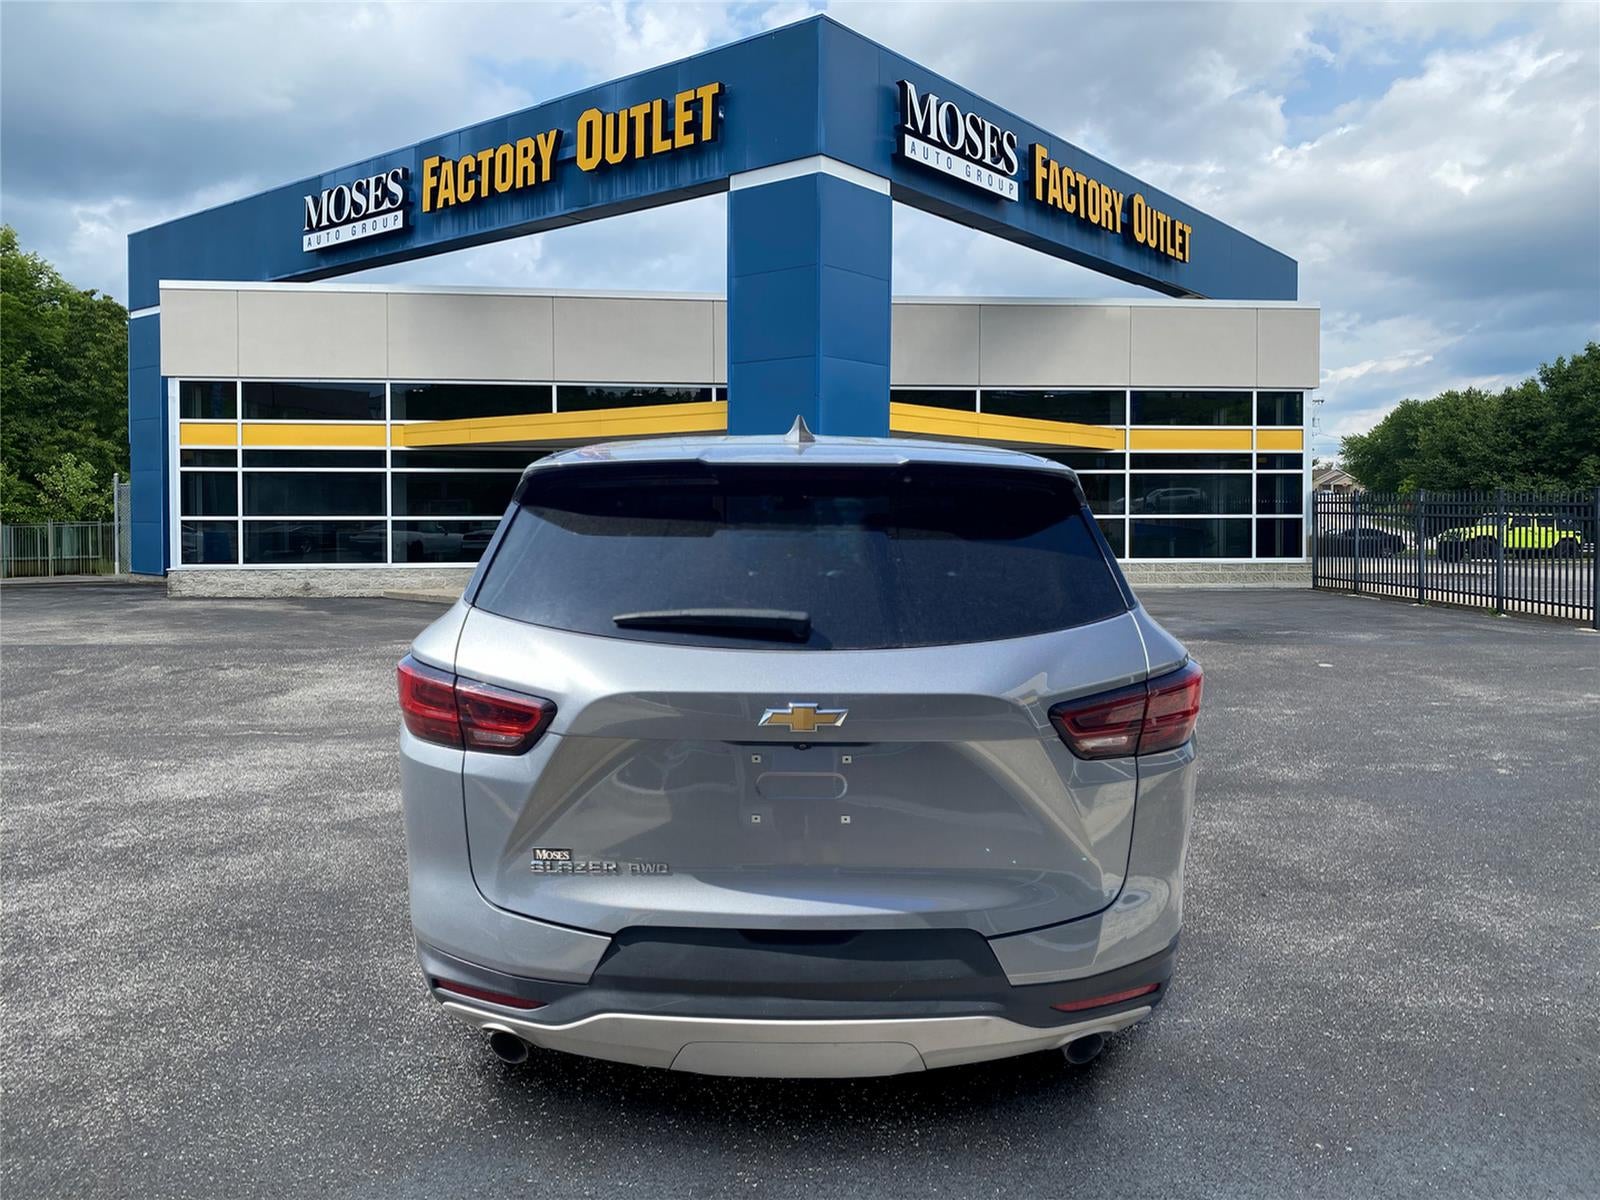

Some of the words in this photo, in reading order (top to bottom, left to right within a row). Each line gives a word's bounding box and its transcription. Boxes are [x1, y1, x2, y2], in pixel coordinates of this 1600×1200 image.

[422, 129, 560, 213] FACTORY
[576, 82, 721, 172] OUTLET
[904, 80, 1019, 176] MOSES
[910, 141, 953, 170] AUTO
[965, 158, 1015, 195] GROUP
[303, 168, 404, 231] MOSES
[1034, 143, 1124, 233] FACTORY
[1132, 193, 1192, 263] OUTLET
[306, 230, 341, 248] AUTO
[350, 215, 400, 239] GROUP
[530, 861, 617, 874] BLAZER
[628, 863, 670, 874] AWD
[535, 849, 570, 860] MOSES
